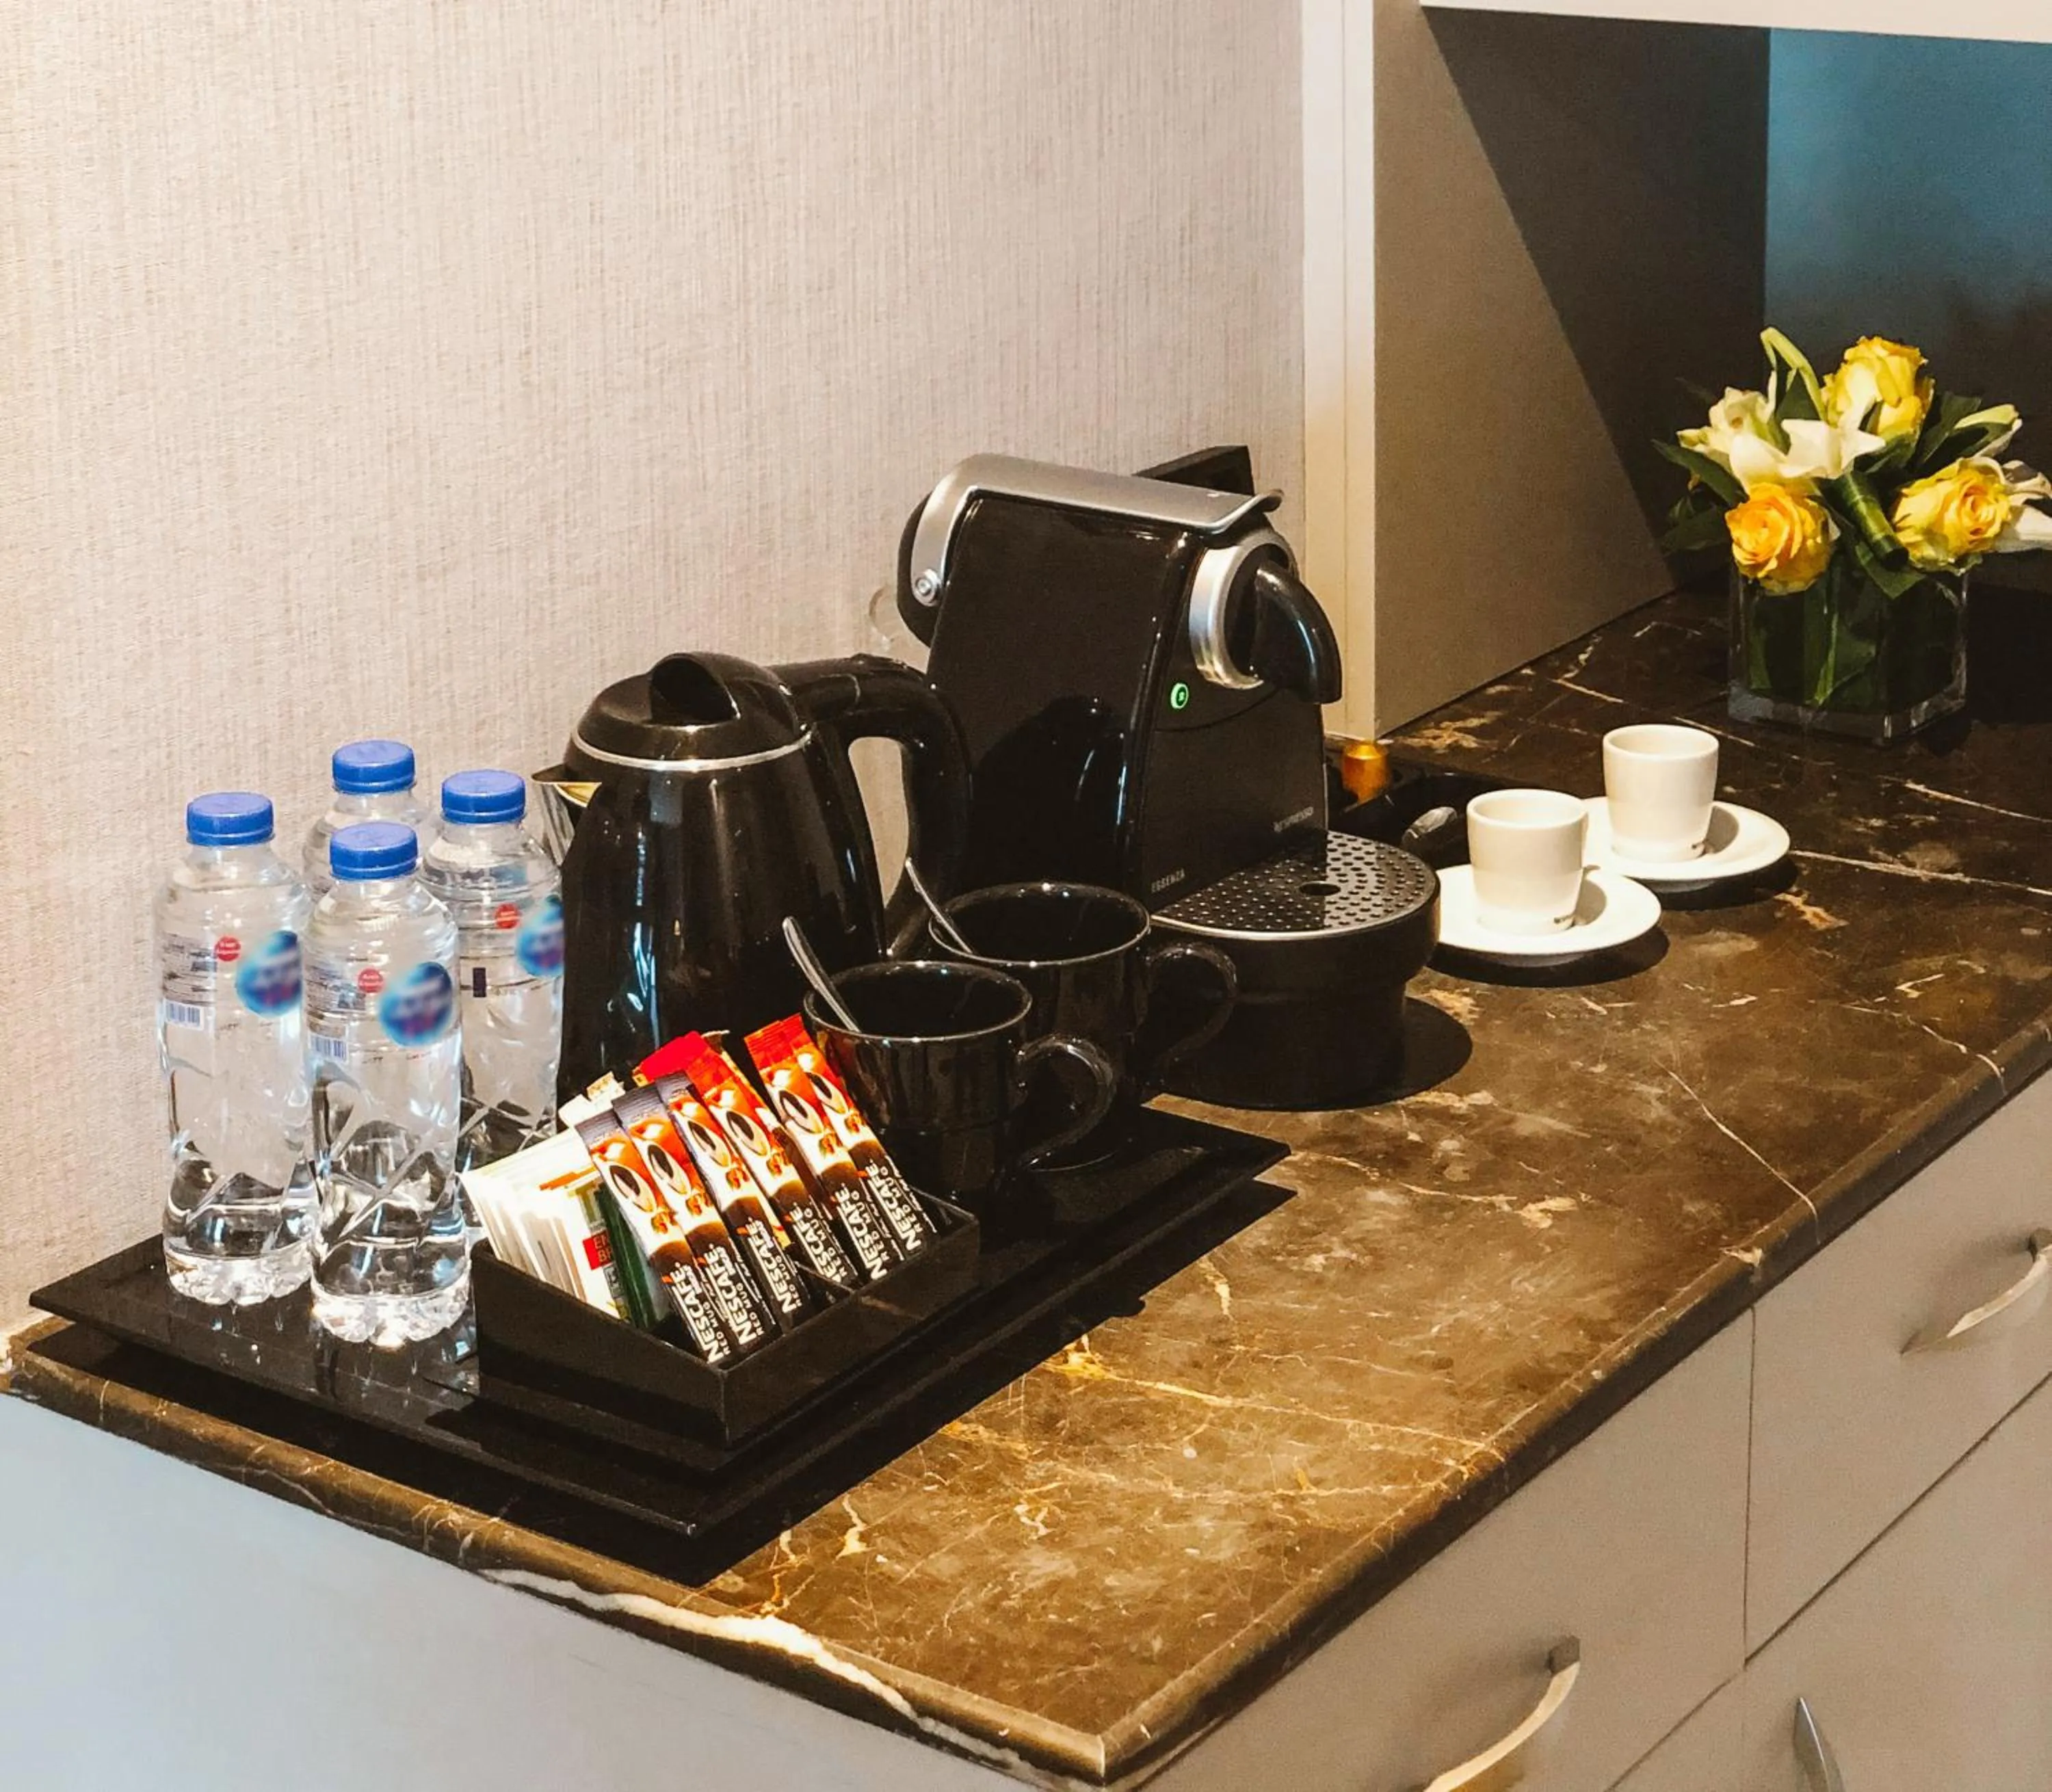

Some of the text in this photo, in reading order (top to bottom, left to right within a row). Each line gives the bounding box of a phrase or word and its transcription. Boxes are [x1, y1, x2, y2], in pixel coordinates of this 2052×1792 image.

[880, 1166, 902, 1198] MUG
[850, 1191, 871, 1224] MUG
[902, 1204, 923, 1233] RED
[804, 1208, 826, 1241] MUG
[871, 1230, 890, 1261] RED
[827, 1247, 847, 1277] RED
[736, 1282, 752, 1308] MUG
[703, 1302, 719, 1328] MUG
[750, 1311, 764, 1336] RED
[716, 1331, 731, 1355] RED
